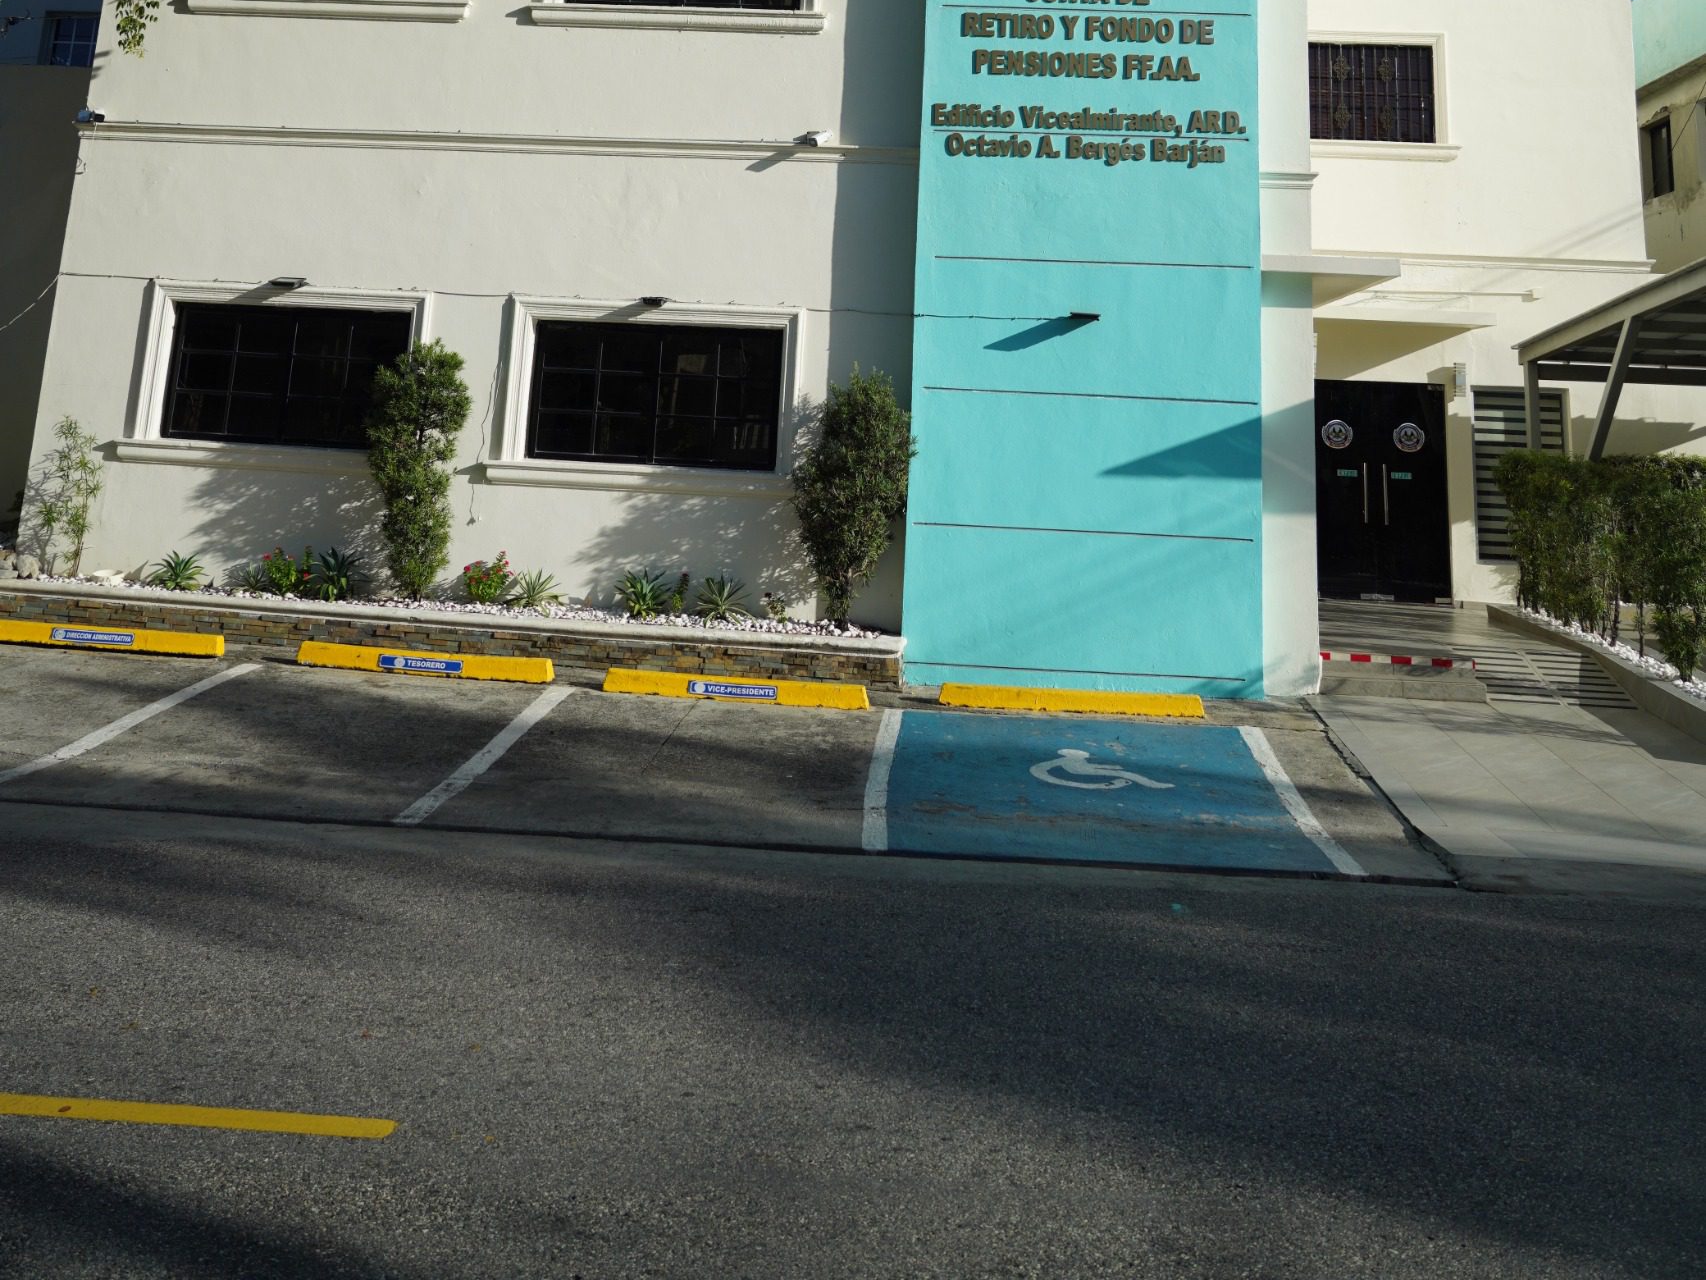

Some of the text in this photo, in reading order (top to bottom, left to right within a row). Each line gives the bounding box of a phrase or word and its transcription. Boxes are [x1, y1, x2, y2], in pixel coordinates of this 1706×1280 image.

[961, 12, 1215, 45] RETIRO Y FONDO DE
[972, 49, 1200, 81] PENSIONES FF.AA.
[931, 102, 1015, 128] Edificio
[1018, 106, 1183, 137] Vicealmirante,
[944, 132, 1226, 169] Octavio A. Bergés Barján
[92, 633, 131, 642] ADMINISTRATIVA
[407, 660, 446, 669] TESORERO
[707, 685, 774, 696] VICE-PRESIDENTE
